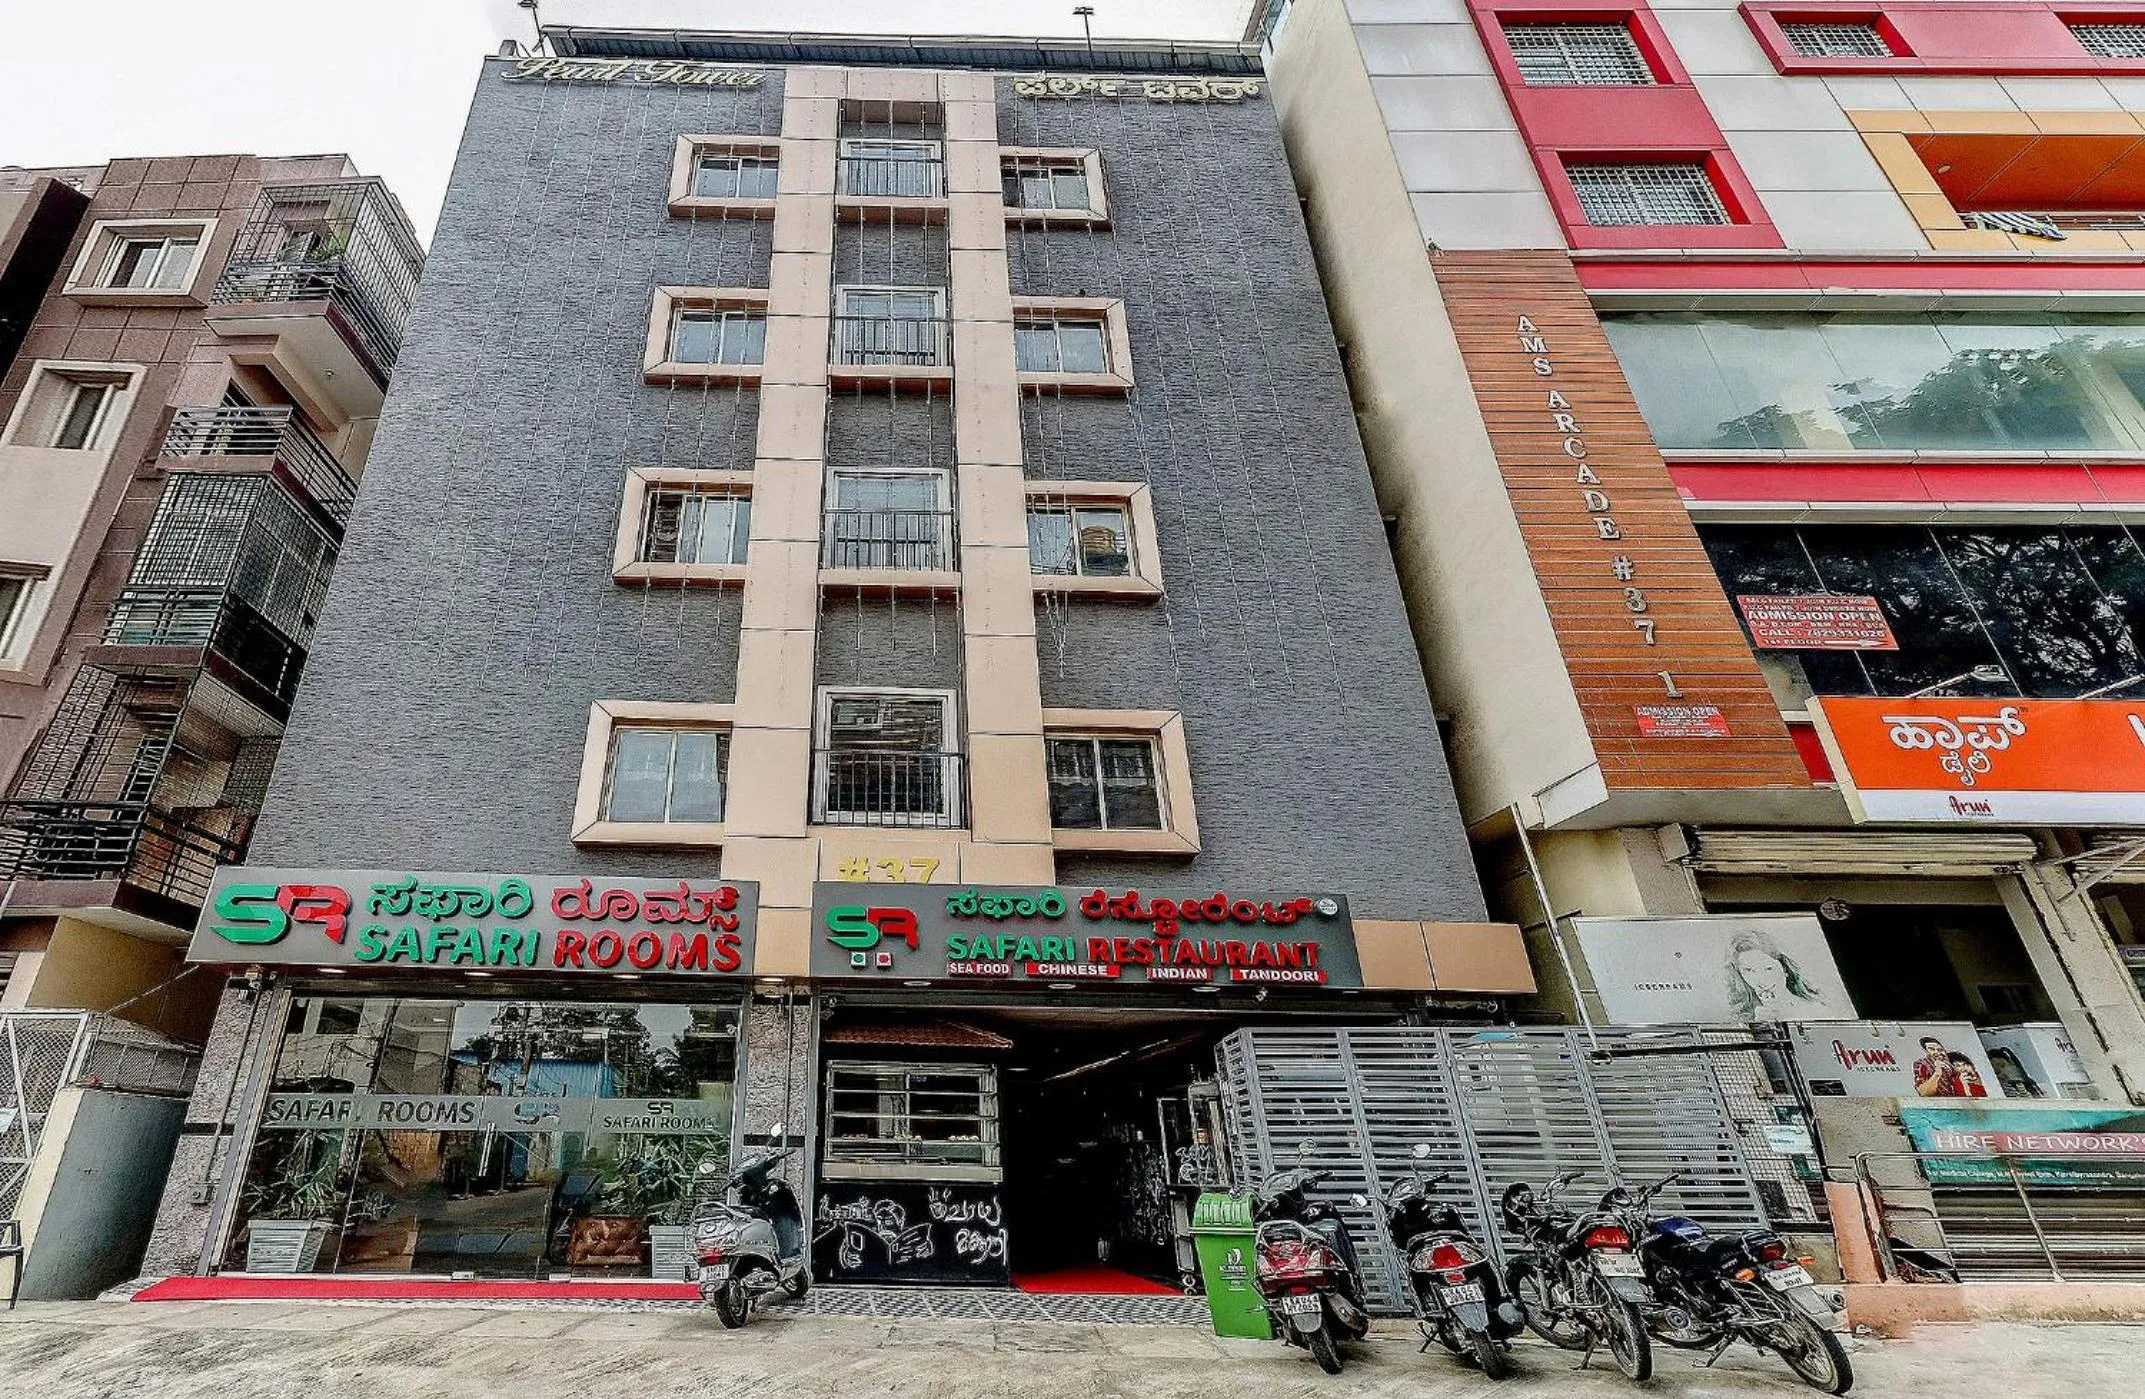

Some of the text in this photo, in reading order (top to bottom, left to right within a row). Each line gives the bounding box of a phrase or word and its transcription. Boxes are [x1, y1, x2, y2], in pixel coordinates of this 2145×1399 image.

[501, 57, 766, 85] Pearl Tower
[1516, 315, 1554, 376] AMS
[1546, 390, 1621, 540] ARCADE
[1748, 611, 1834, 620] ADMISSION
[354, 925, 741, 971] SAFARI ROOMS
[946, 932, 1322, 969] SAFARI RESTAURANT
[949, 962, 1010, 974] SEA FOOD
[1037, 963, 1108, 976] CHINESE
[1151, 967, 1208, 980] INDIAN
[1239, 969, 1320, 982] TANDOORI
[1832, 1040, 1896, 1070] Arun
[378, 1101, 475, 1125] ROOMS
[604, 1116, 656, 1129] SAFARI
[1935, 1132, 1996, 1149] HIRE
